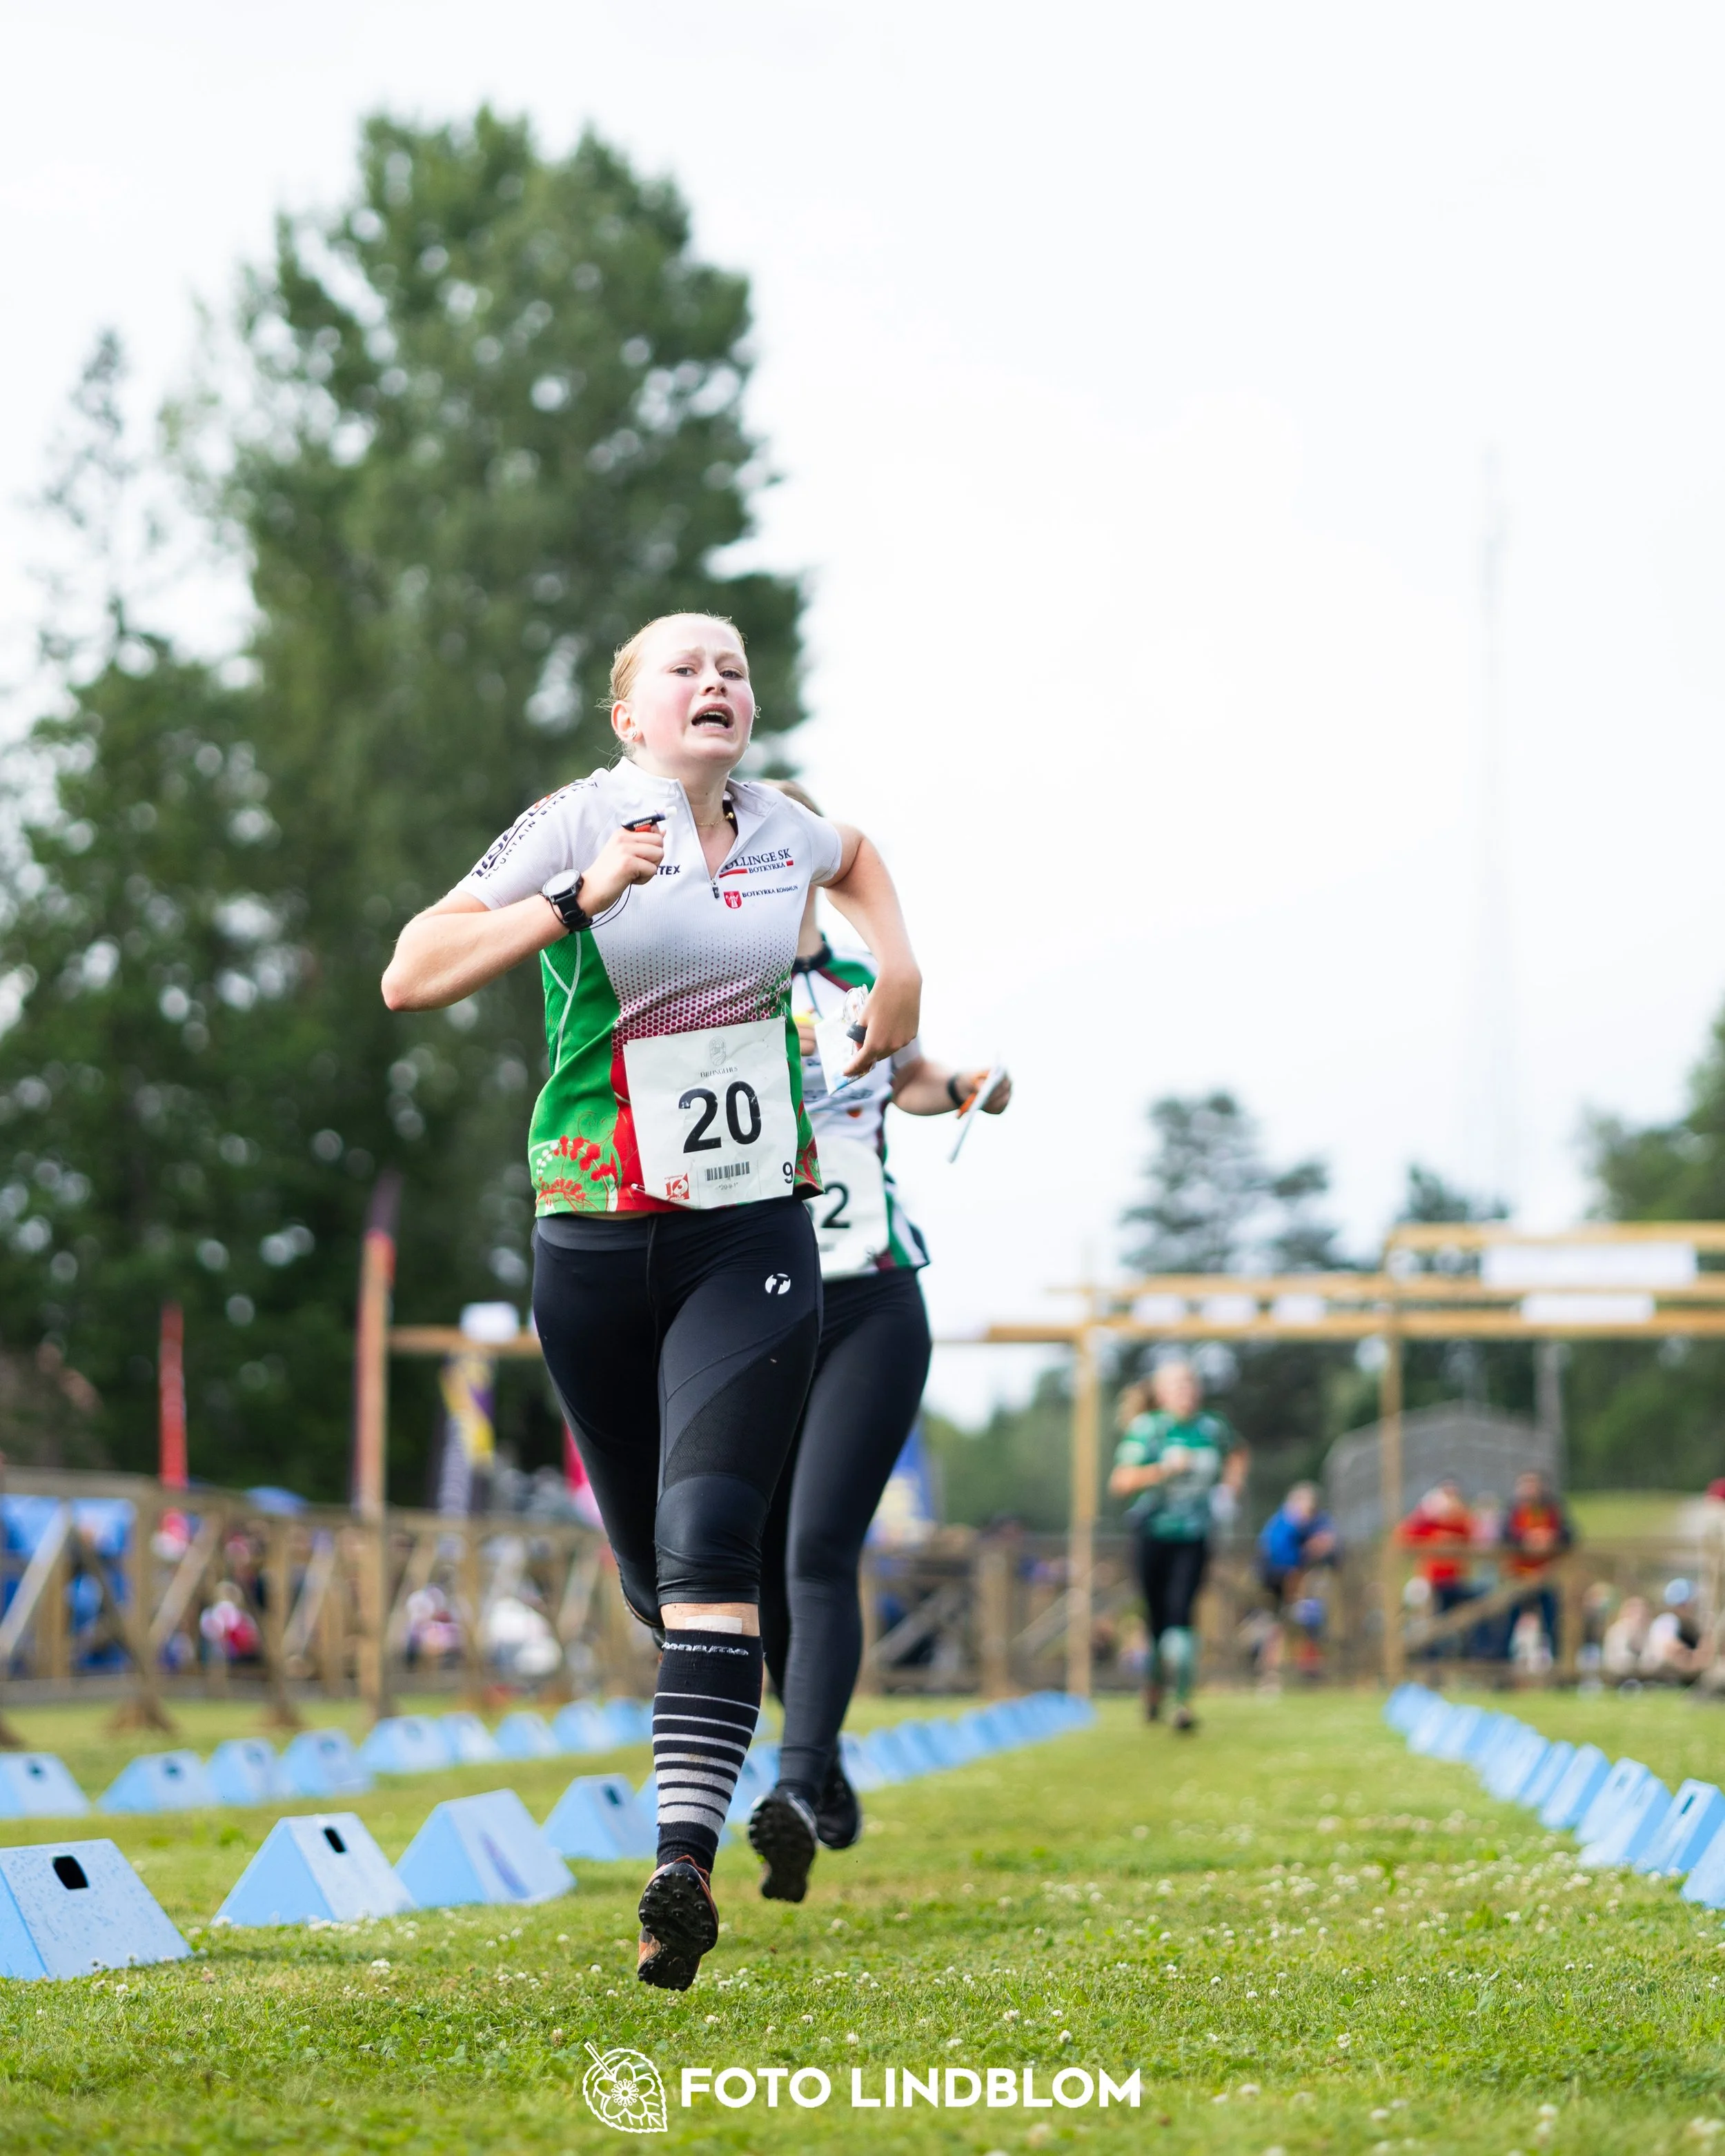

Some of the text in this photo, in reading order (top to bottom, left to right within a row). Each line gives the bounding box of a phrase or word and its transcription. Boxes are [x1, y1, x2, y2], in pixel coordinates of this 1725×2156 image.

[778, 848, 792, 860] SK
[655, 864, 680, 875] TEX
[749, 862, 786, 873] BOTKYRKA
[742, 884, 798, 898] BOTKYRKA KOMMUN
[678, 1080, 762, 1154] 20
[782, 1161, 793, 1184] 9
